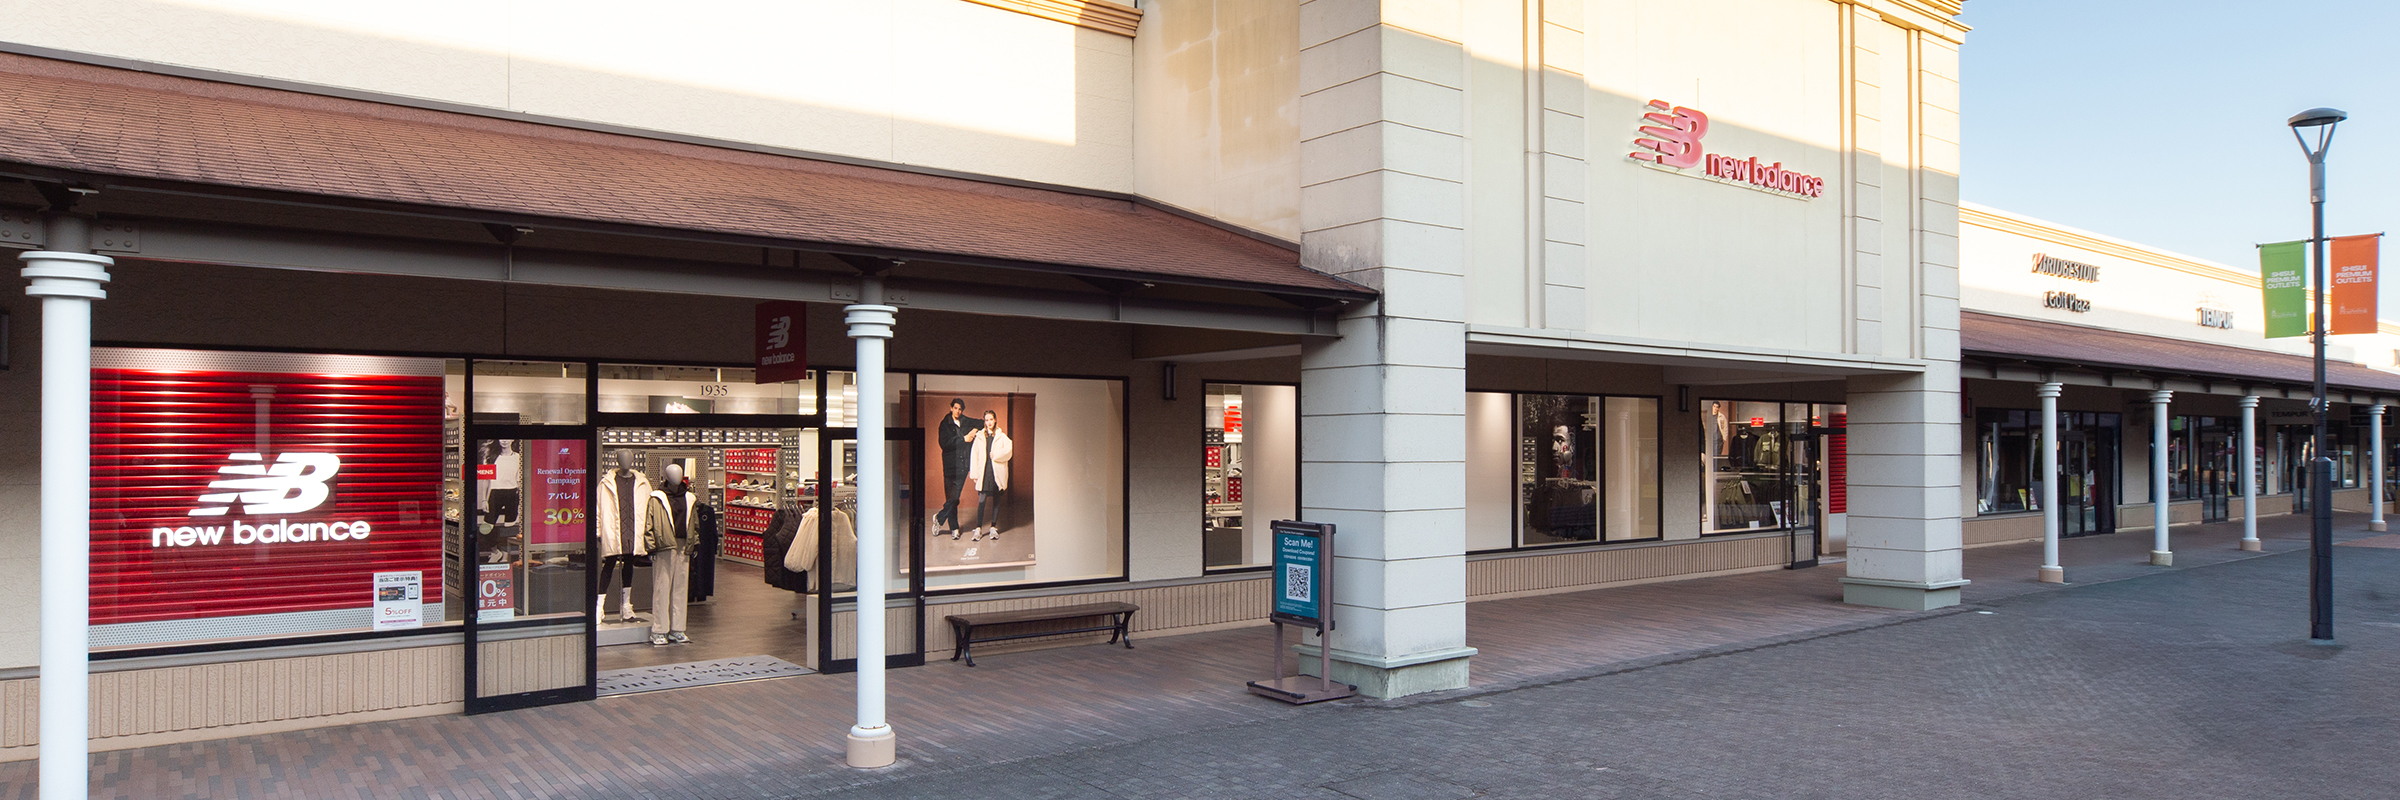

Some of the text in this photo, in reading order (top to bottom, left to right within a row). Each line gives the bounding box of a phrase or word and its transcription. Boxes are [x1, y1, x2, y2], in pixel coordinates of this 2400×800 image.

[1706, 153, 1824, 198] new balance
[2336, 270, 2372, 278] PREMIUM
[2266, 275, 2300, 283] PREMIUM
[2336, 276, 2372, 284] OUTLETS
[2266, 281, 2300, 289] OUTLETS
[2043, 291, 2067, 310] Golf
[762, 352, 795, 366] new balance
[701, 385, 728, 397] 1935
[2271, 410, 2309, 418] TEMPUR
[564, 468, 587, 476] Openin
[546, 477, 580, 485] Campaign
[543, 507, 584, 525] 30%
[152, 518, 371, 547] new balance
[1284, 537, 1313, 549] Scan Me!
[1282, 546, 1299, 555] Download
[385, 607, 412, 616] 5%OFF
